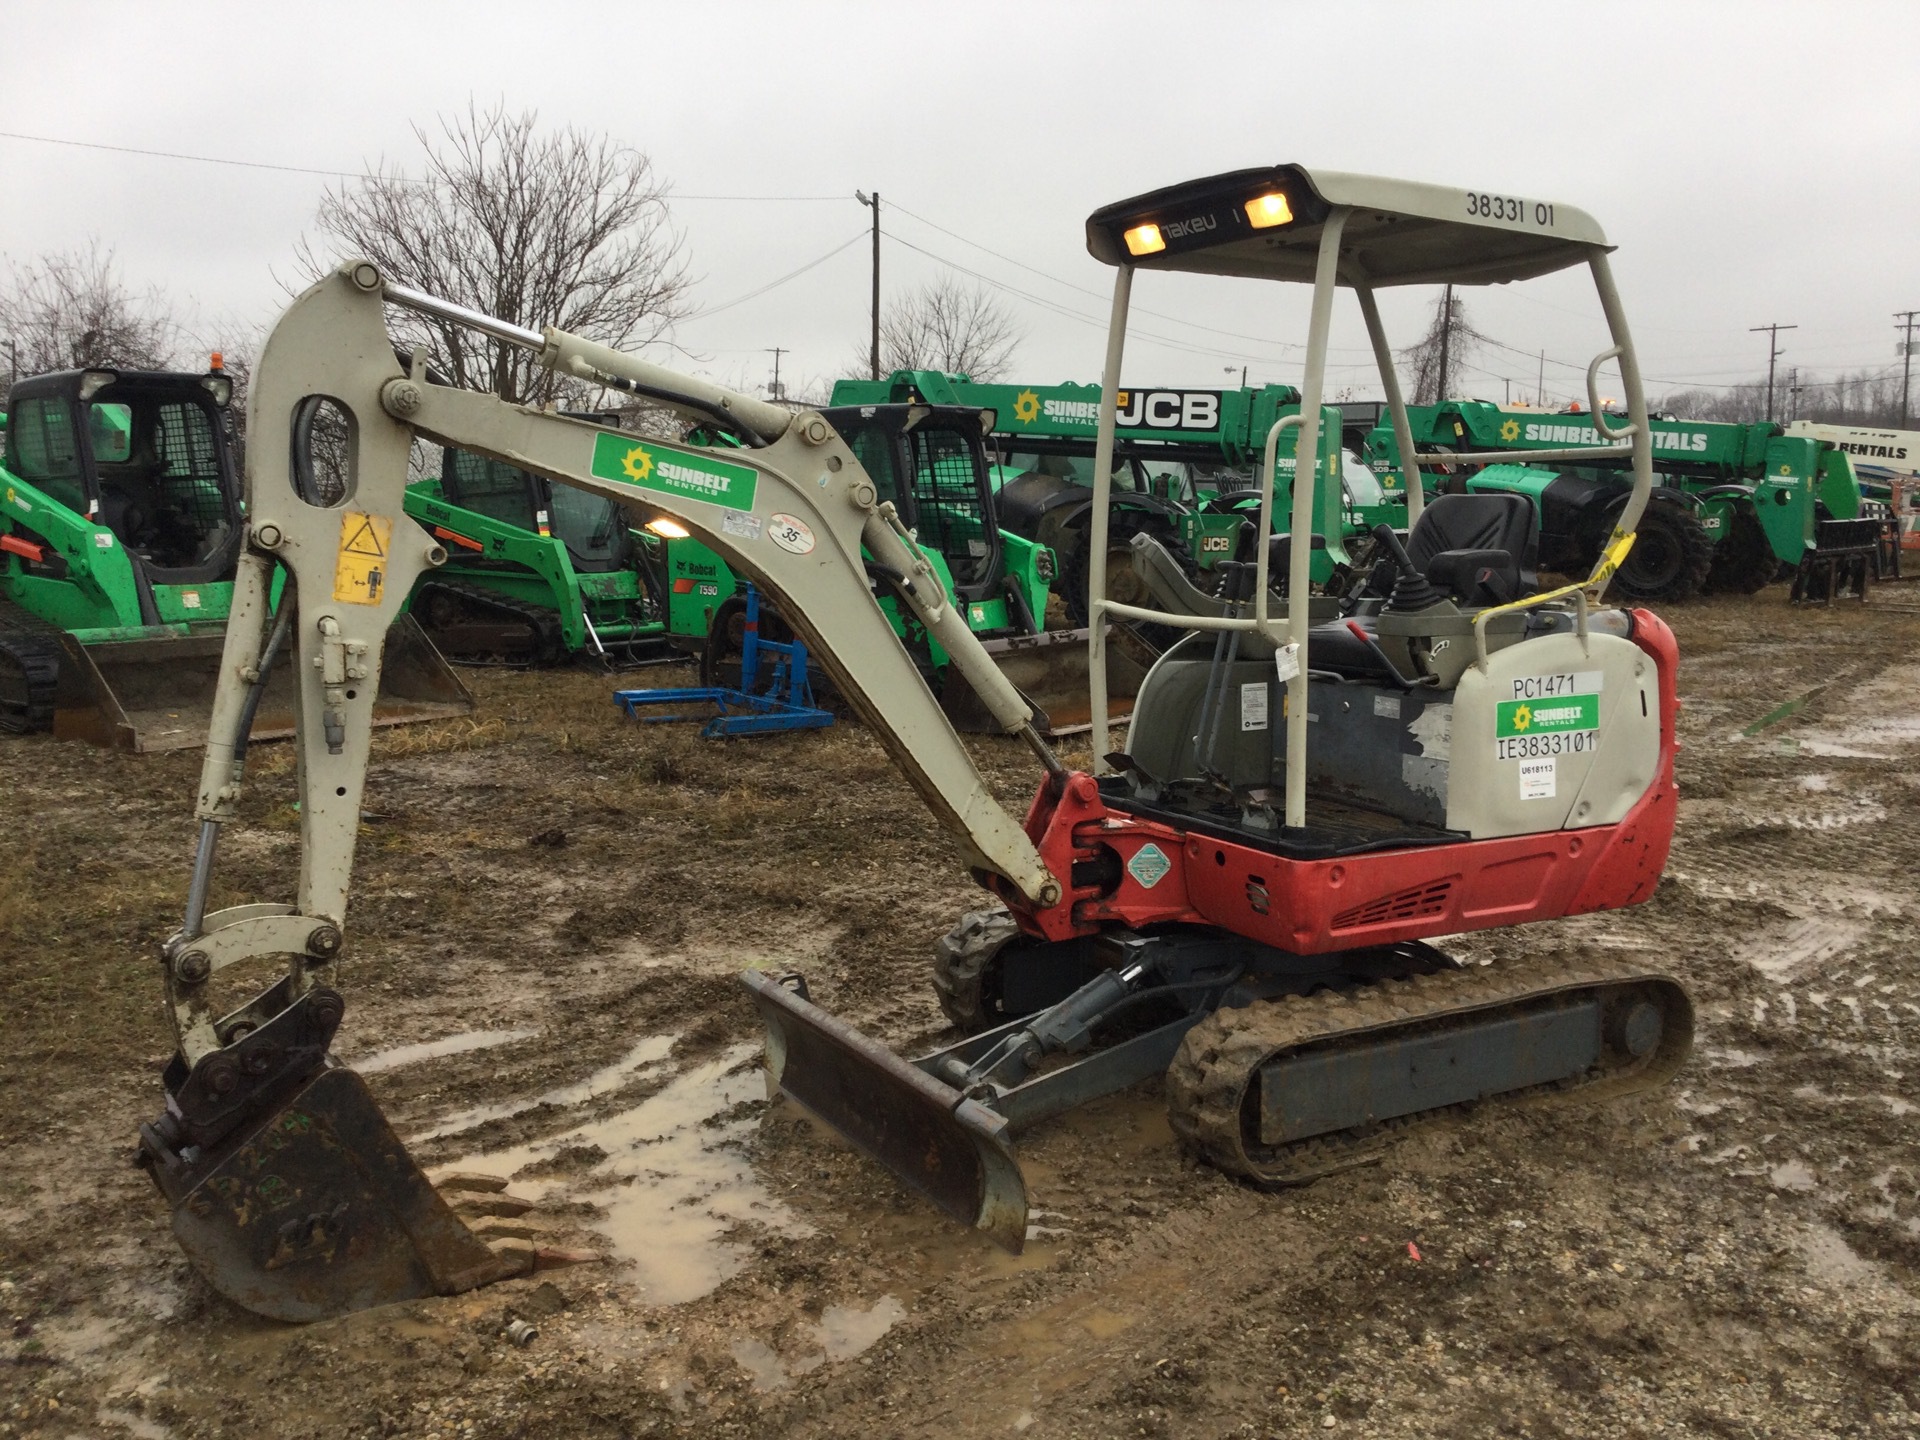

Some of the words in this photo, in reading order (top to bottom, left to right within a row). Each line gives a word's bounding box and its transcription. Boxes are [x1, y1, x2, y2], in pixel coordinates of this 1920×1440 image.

[1466, 192, 1524, 223] 38331
[1535, 203, 1554, 227] 01
[1043, 399, 1101, 419] SUNBE
[1115, 392, 1219, 429] JCB
[1612, 429, 1708, 452] TALS
[1839, 442, 1908, 460] RENTALS
[657, 461, 731, 492] SUNBELT
[666, 478, 718, 496] RENTALS
[781, 527, 800, 543] 35
[1203, 537, 1230, 552] JCB
[689, 562, 717, 577] Bobcat
[699, 584, 718, 596] T590
[1513, 674, 1575, 699] PC1471
[1533, 706, 1583, 723] SUNBELT
[1539, 719, 1575, 727] RENTALS
[1498, 731, 1593, 760] IE3833101
[1521, 764, 1554, 775] U618113
